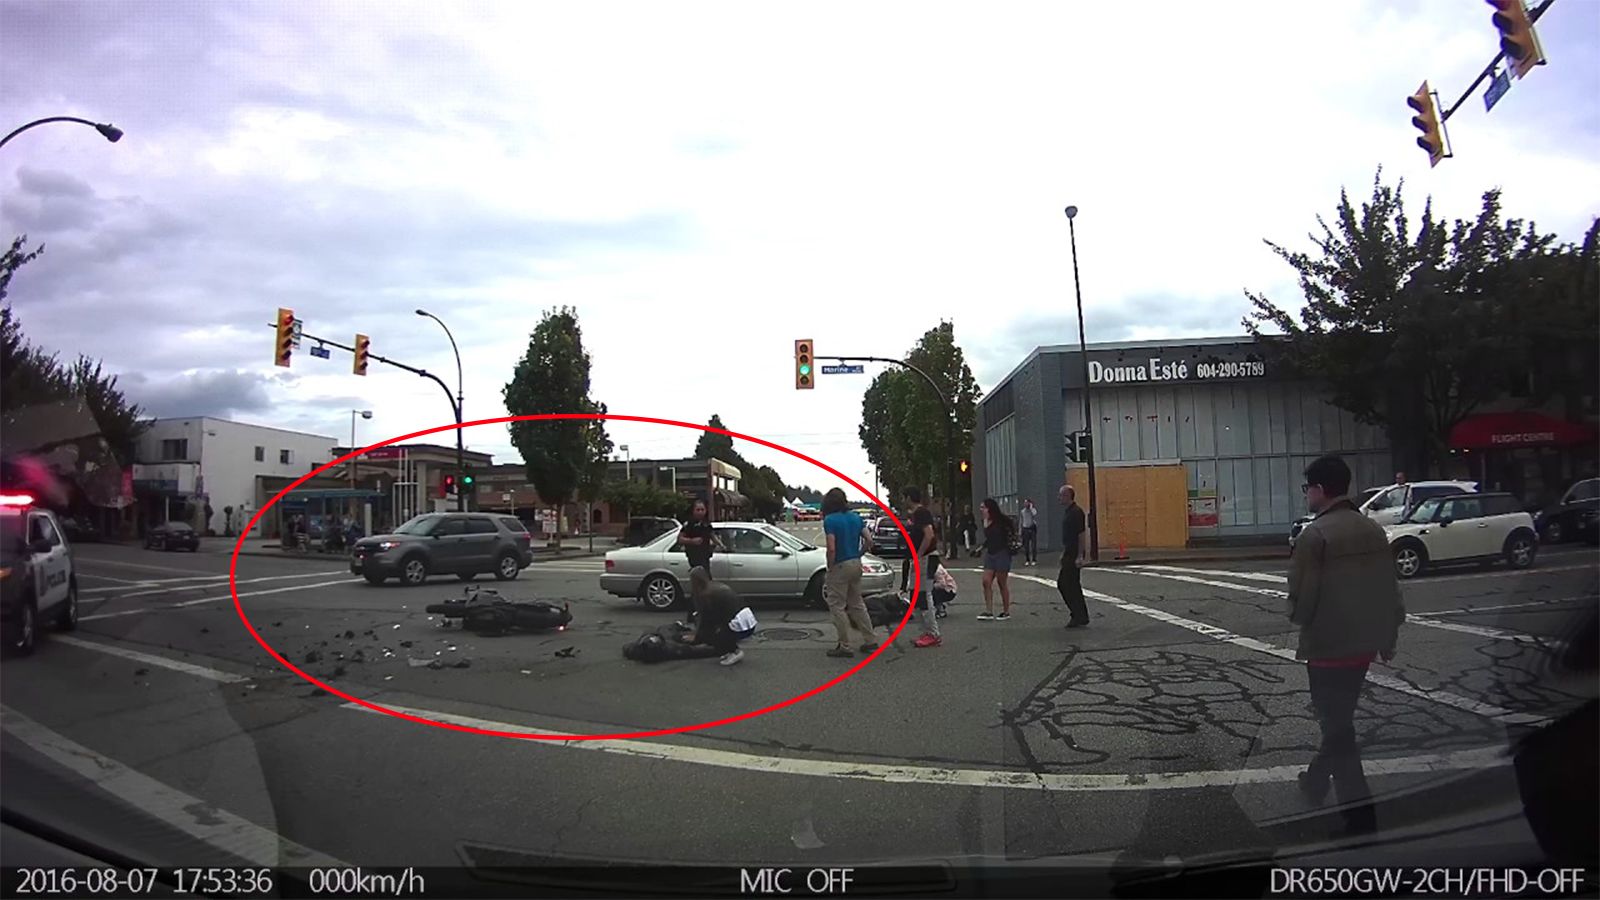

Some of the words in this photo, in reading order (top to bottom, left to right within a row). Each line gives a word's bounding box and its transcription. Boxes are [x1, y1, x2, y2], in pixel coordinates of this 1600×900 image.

[1088, 361, 1147, 383] Donna
[1150, 358, 1188, 380] Esté
[1197, 362, 1265, 378] 604-290-5789
[1492, 433, 1521, 443] FLIGHT
